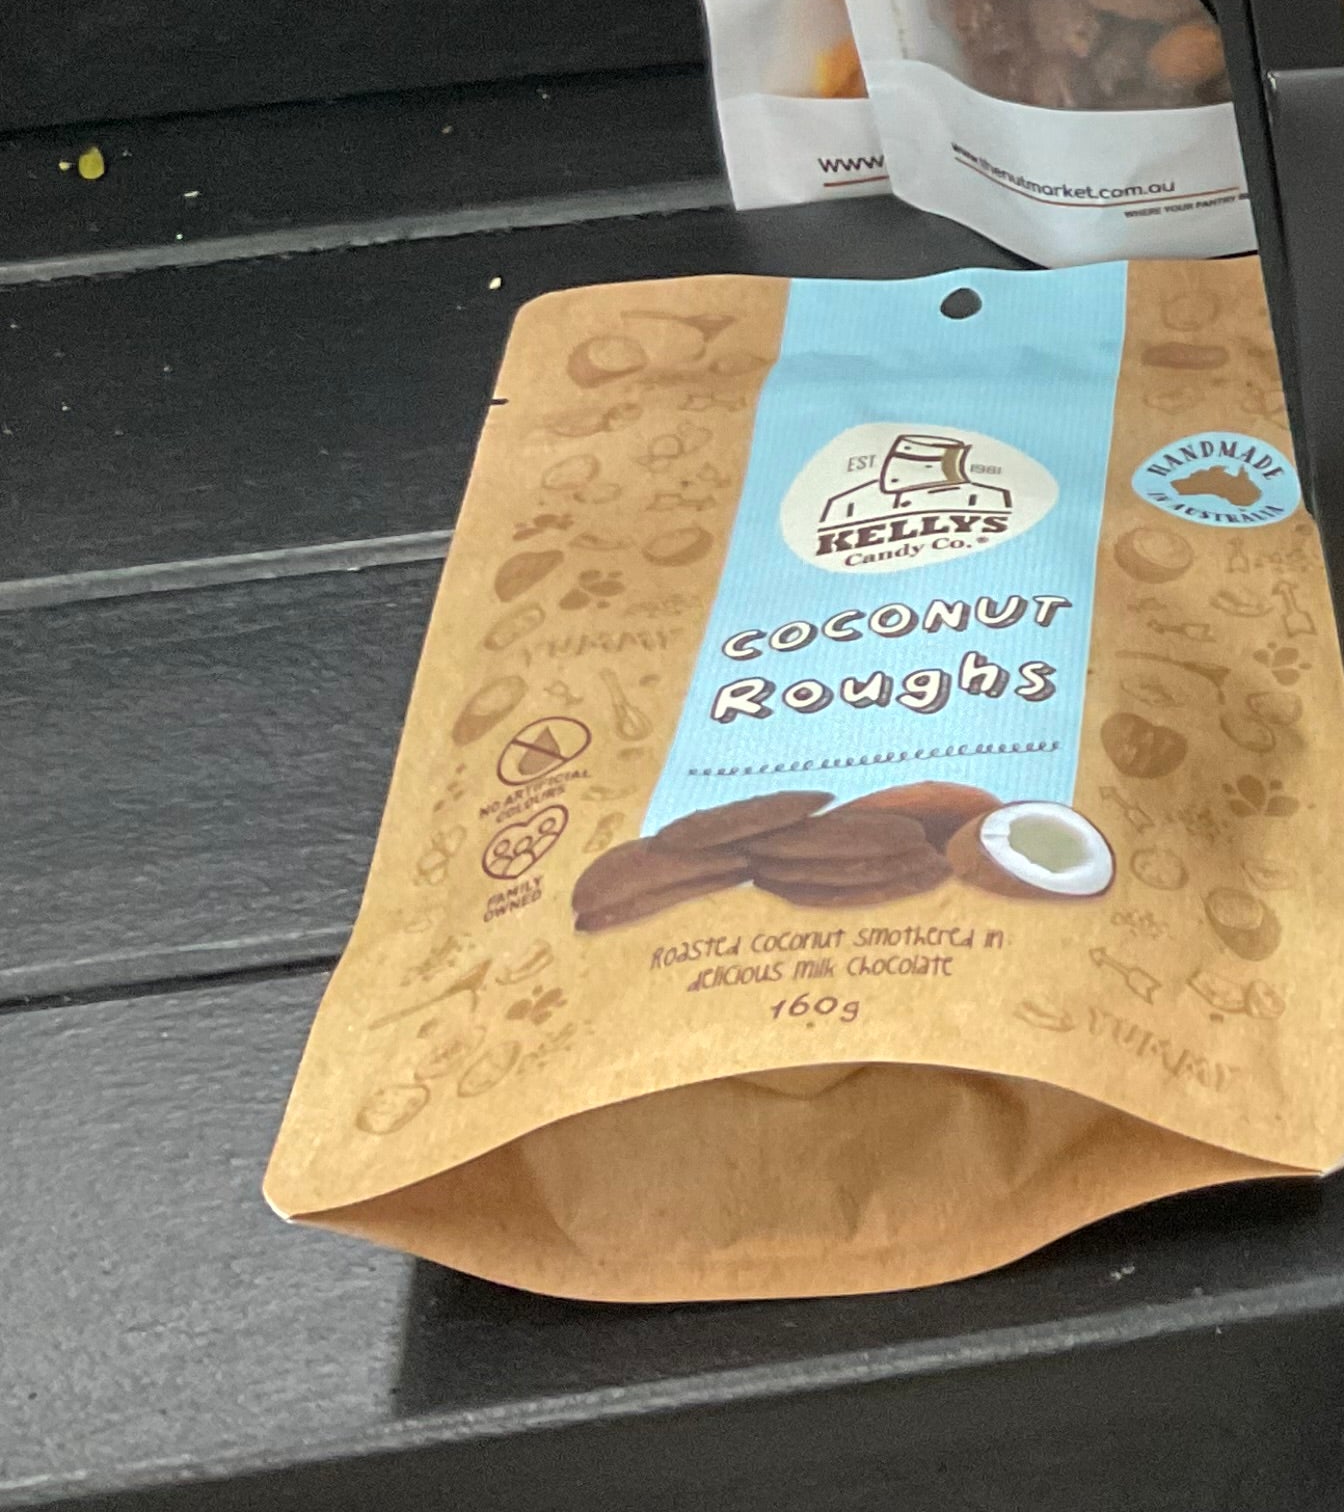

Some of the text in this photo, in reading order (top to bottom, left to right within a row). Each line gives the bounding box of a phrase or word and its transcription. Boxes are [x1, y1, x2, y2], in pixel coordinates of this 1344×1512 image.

[951, 142, 1176, 201] www.thenutmarket.com.au
[846, 453, 878, 474] EST
[1146, 439, 1286, 482] HANDMADE
[1169, 502, 1286, 525] AUSTRALIA
[814, 514, 1010, 557] KELLYS
[843, 537, 974, 567] Candy Co.
[720, 594, 1074, 662] COCONUT
[709, 649, 1058, 725] Roughs
[495, 785, 567, 824] COLOURS
[503, 767, 592, 807] ARTIFICIAL
[483, 888, 543, 924] OWNED
[486, 875, 544, 911] FAMILY
[852, 925, 976, 950] smothered
[983, 928, 1006, 950] in
[686, 961, 785, 994] delicious
[792, 956, 836, 982] milk
[769, 991, 861, 1024] 160g
